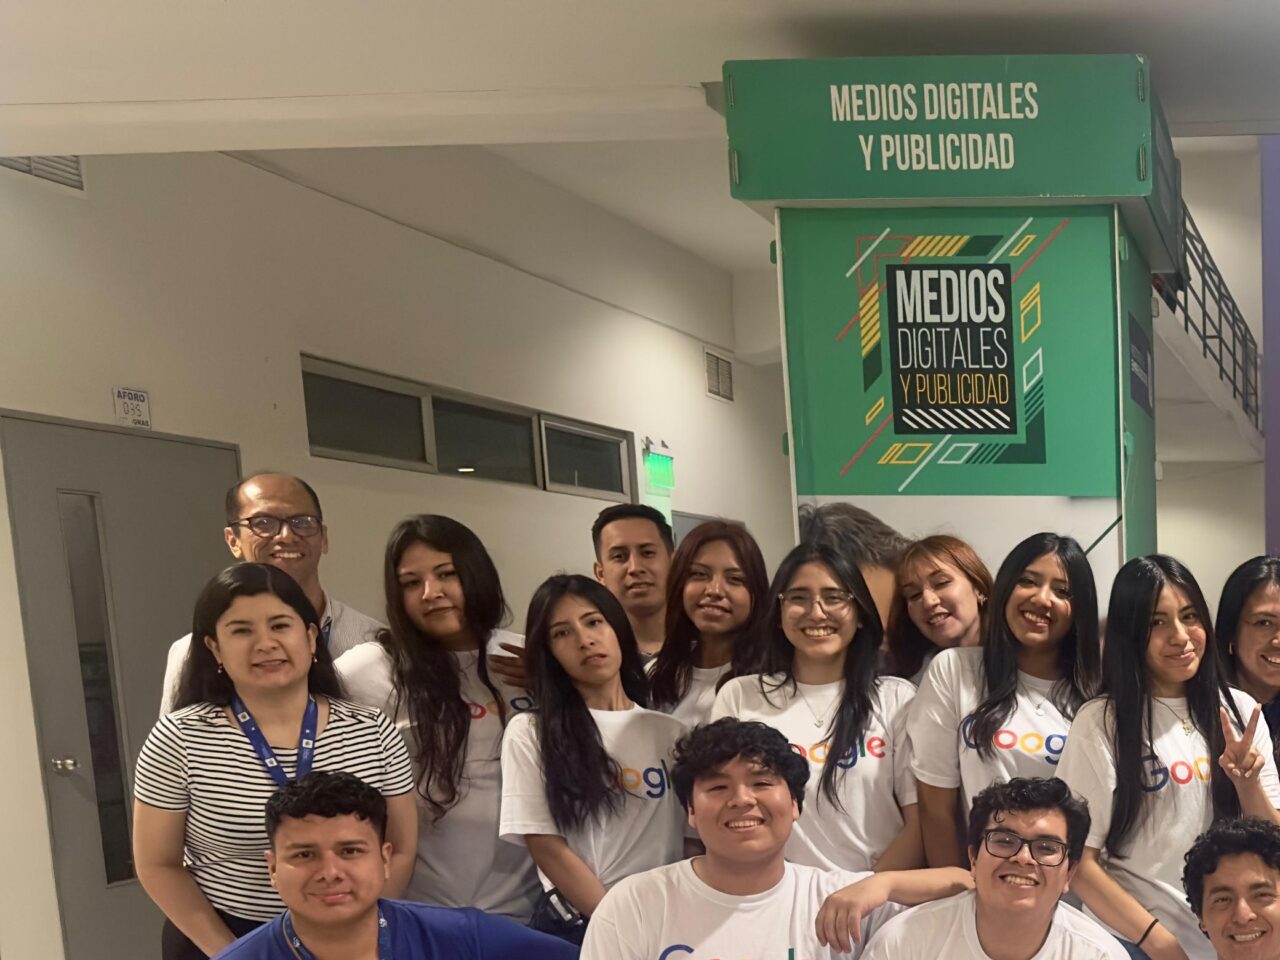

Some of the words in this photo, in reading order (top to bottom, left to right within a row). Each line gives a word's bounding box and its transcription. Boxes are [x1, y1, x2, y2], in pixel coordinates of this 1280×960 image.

[830, 83, 918, 122] MEDIOS
[923, 82, 1039, 120] DIGITALES
[858, 134, 874, 171] Y
[880, 133, 1015, 171] PUBLICIDAD
[895, 269, 1006, 323] MEDIOS
[897, 327, 1008, 369] DIGITALES
[117, 390, 146, 402] AFORO
[900, 374, 911, 405] Y
[916, 373, 1009, 405] PUBLICIDAD
